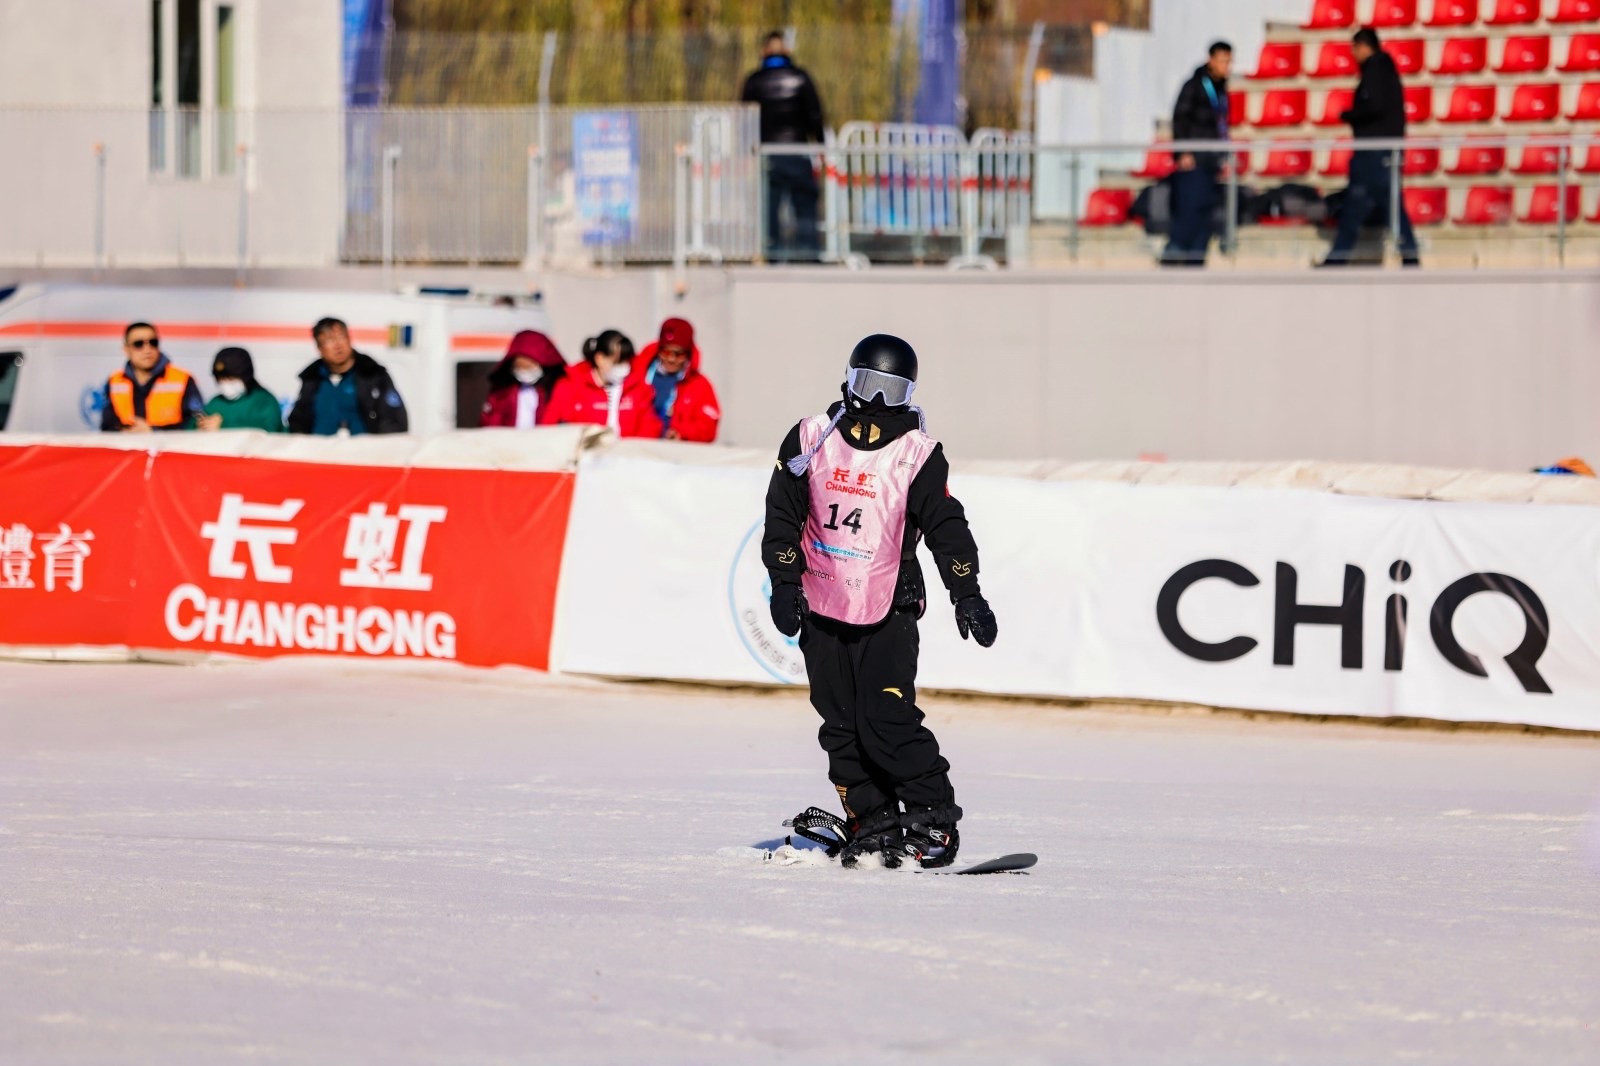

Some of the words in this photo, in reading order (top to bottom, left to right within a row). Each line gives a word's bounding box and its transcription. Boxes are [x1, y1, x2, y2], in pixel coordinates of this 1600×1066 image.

[826, 481, 876, 499] CHANGHONG
[833, 467, 876, 488] 长虹
[201, 493, 447, 591] 长虹
[823, 503, 863, 535] 14
[164, 583, 456, 658] CHANGHONG
[1156, 558, 1554, 694] CHiQ
